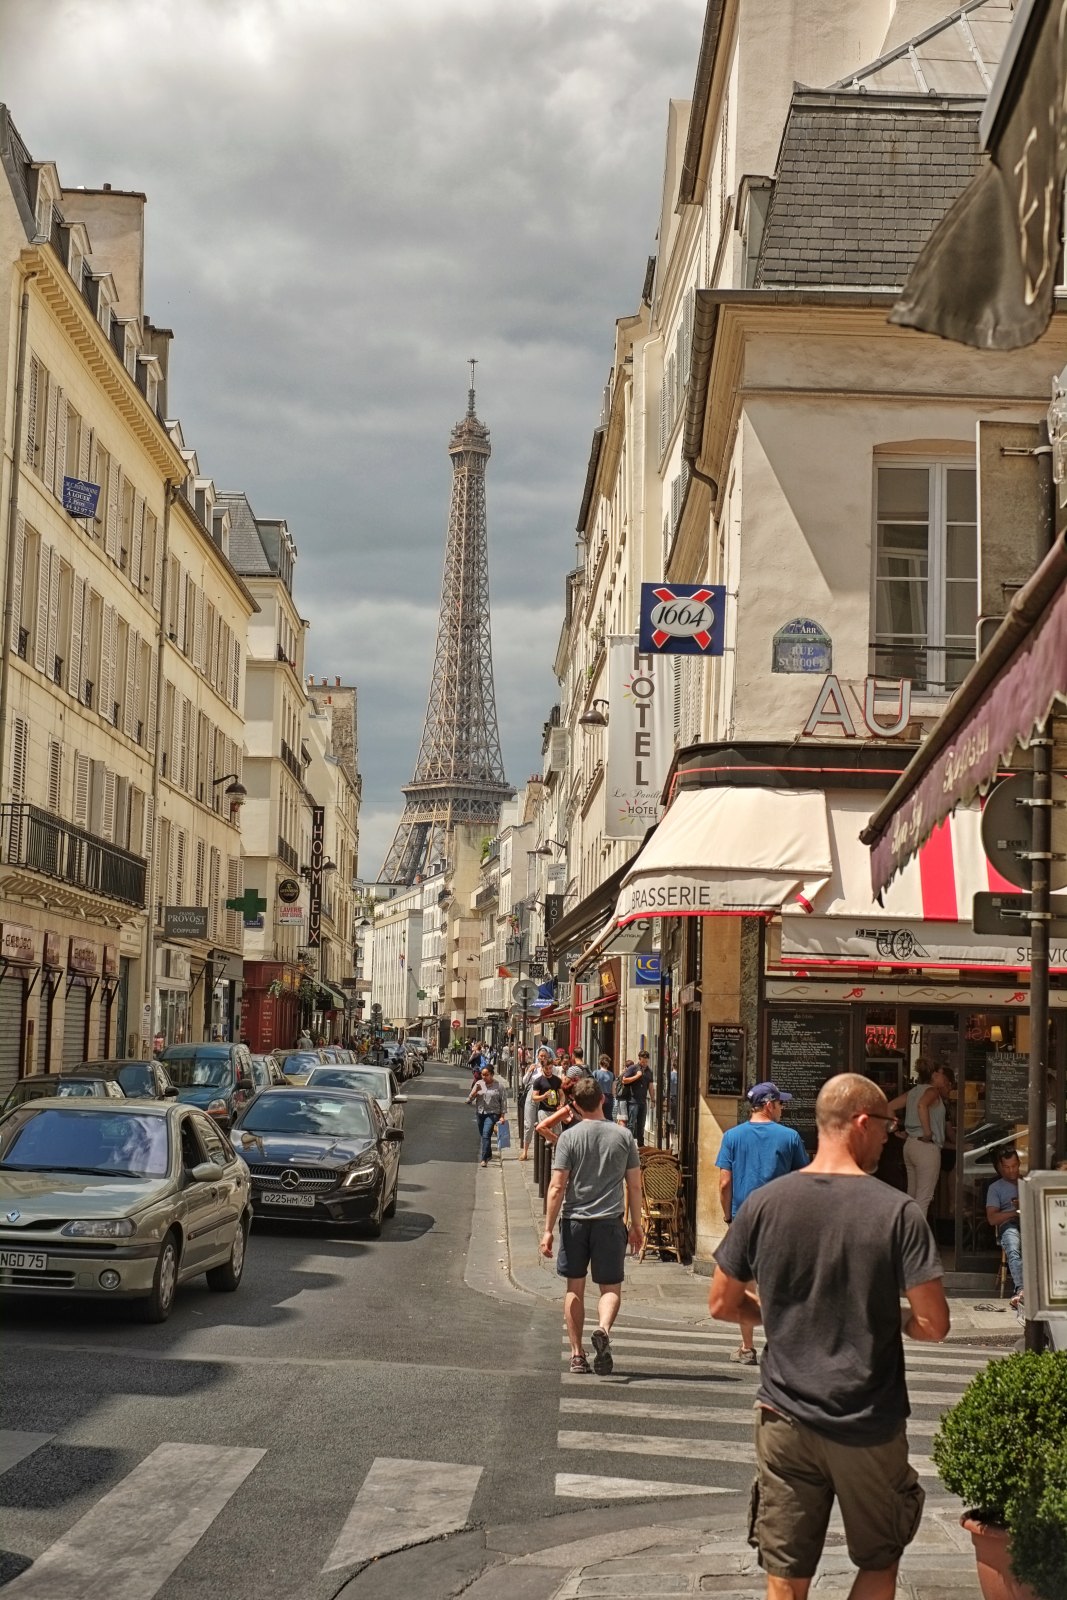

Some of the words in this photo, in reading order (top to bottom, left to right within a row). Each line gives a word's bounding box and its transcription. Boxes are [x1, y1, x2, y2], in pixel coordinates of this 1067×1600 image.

[72, 492, 90, 502] LOUER
[657, 603, 708, 627] 1664
[631, 646, 655, 786] HOTEL
[802, 675, 911, 738] AU
[628, 806, 658, 815] HOTEL
[309, 810, 324, 944] THOUMIEUX
[631, 886, 711, 910] BRASSERIE
[167, 914, 205, 923] PROVOST
[1, 1253, 25, 1267] NGD
[28, 1255, 44, 1268] 75
